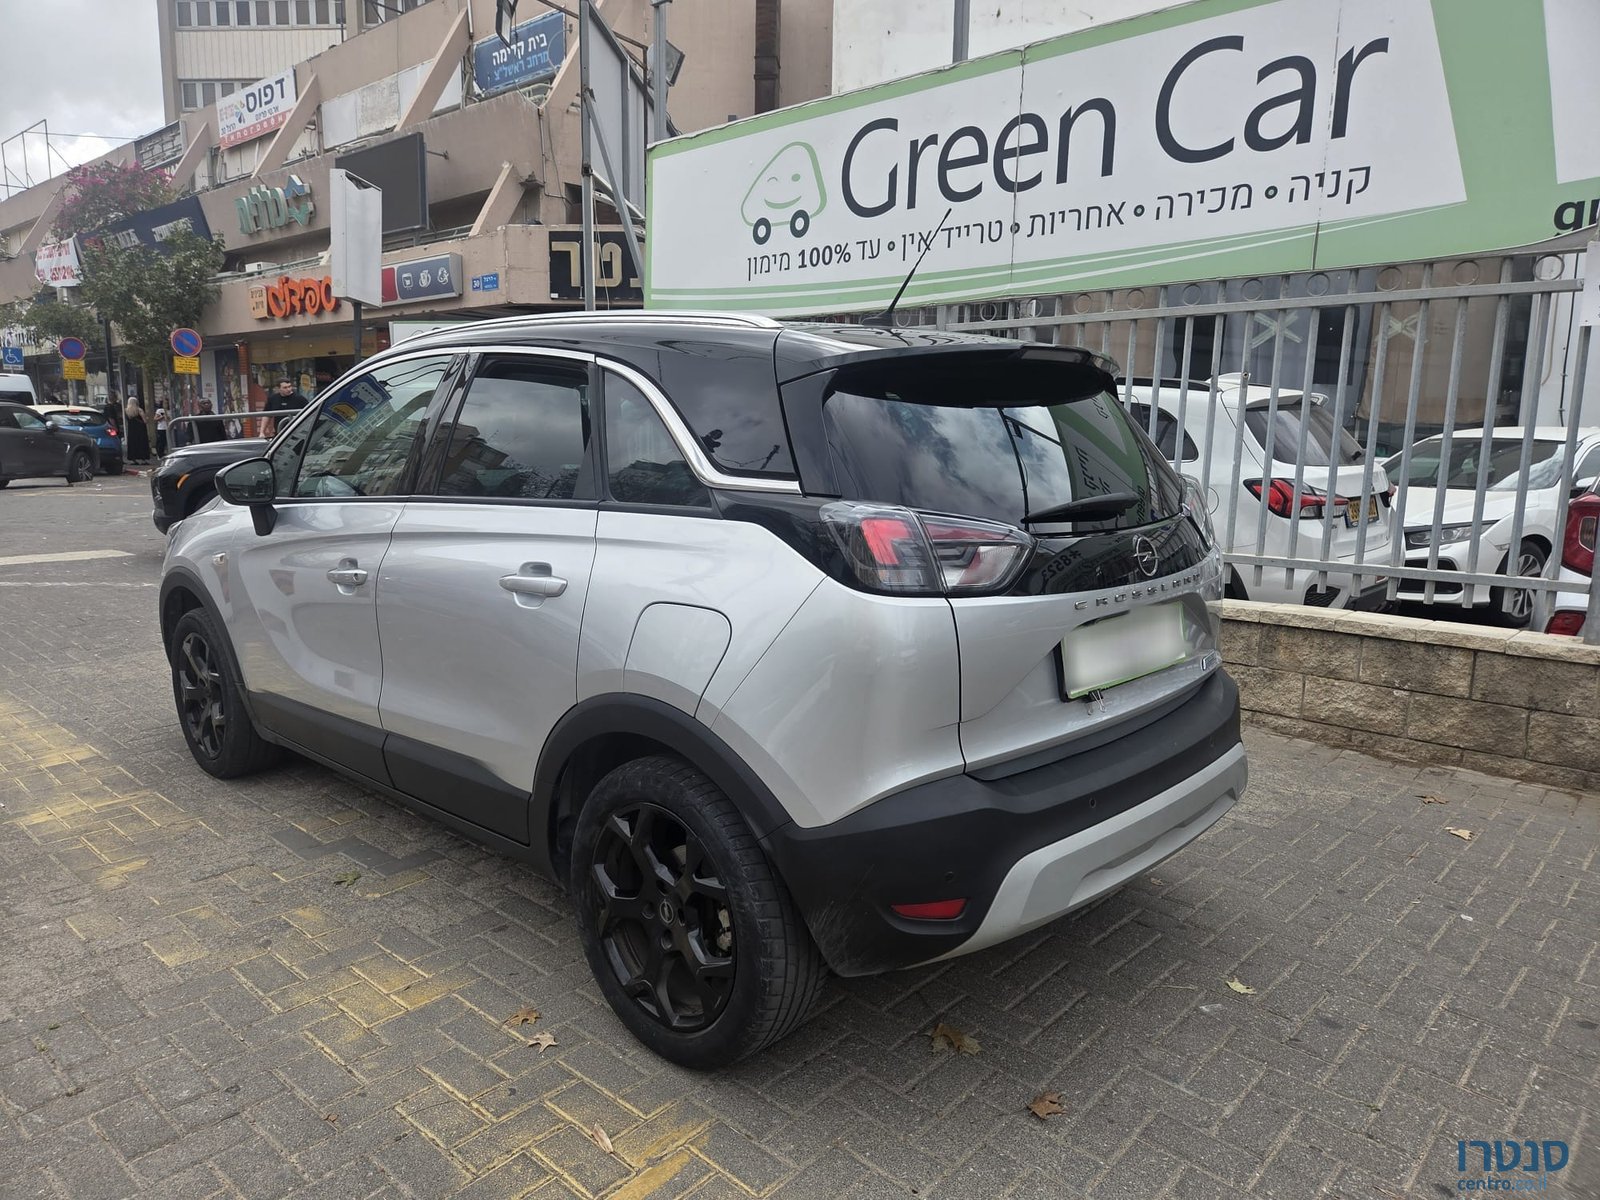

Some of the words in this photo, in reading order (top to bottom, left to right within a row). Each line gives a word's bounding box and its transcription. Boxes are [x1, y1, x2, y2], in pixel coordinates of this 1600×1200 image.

[528, 33, 548, 52] בית
[245, 77, 285, 113] דפוס
[841, 97, 1117, 218] Green
[1154, 35, 1390, 164] Car
[1287, 165, 1372, 204] קניה
[1154, 183, 1253, 221] מכירה
[941, 219, 1003, 249] טרייד
[1027, 200, 1127, 239] אחריות
[798, 242, 852, 269] 100%
[857, 238, 881, 260] עד
[902, 230, 932, 262] אין
[747, 252, 791, 282] מימון
